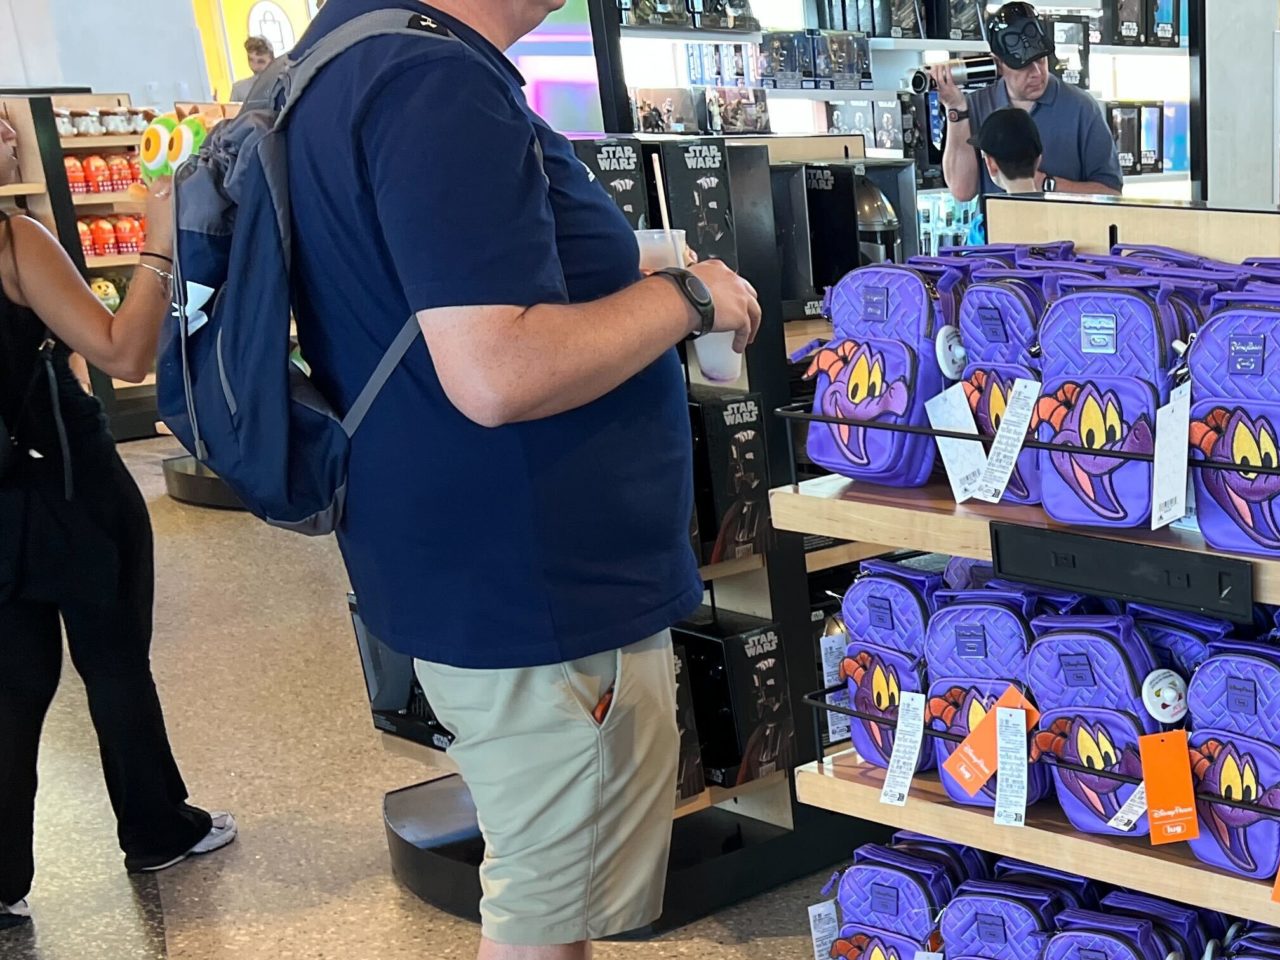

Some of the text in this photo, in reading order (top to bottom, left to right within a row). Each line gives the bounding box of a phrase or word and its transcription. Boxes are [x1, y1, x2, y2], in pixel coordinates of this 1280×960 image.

[597, 146, 636, 159] STAR
[684, 145, 722, 158] STAR
[599, 158, 637, 171] WARS
[685, 156, 722, 169] WARS
[723, 401, 759, 416] STAR
[724, 412, 757, 426] WARS
[744, 632, 778, 650] STAR
[745, 641, 777, 658] WARS
